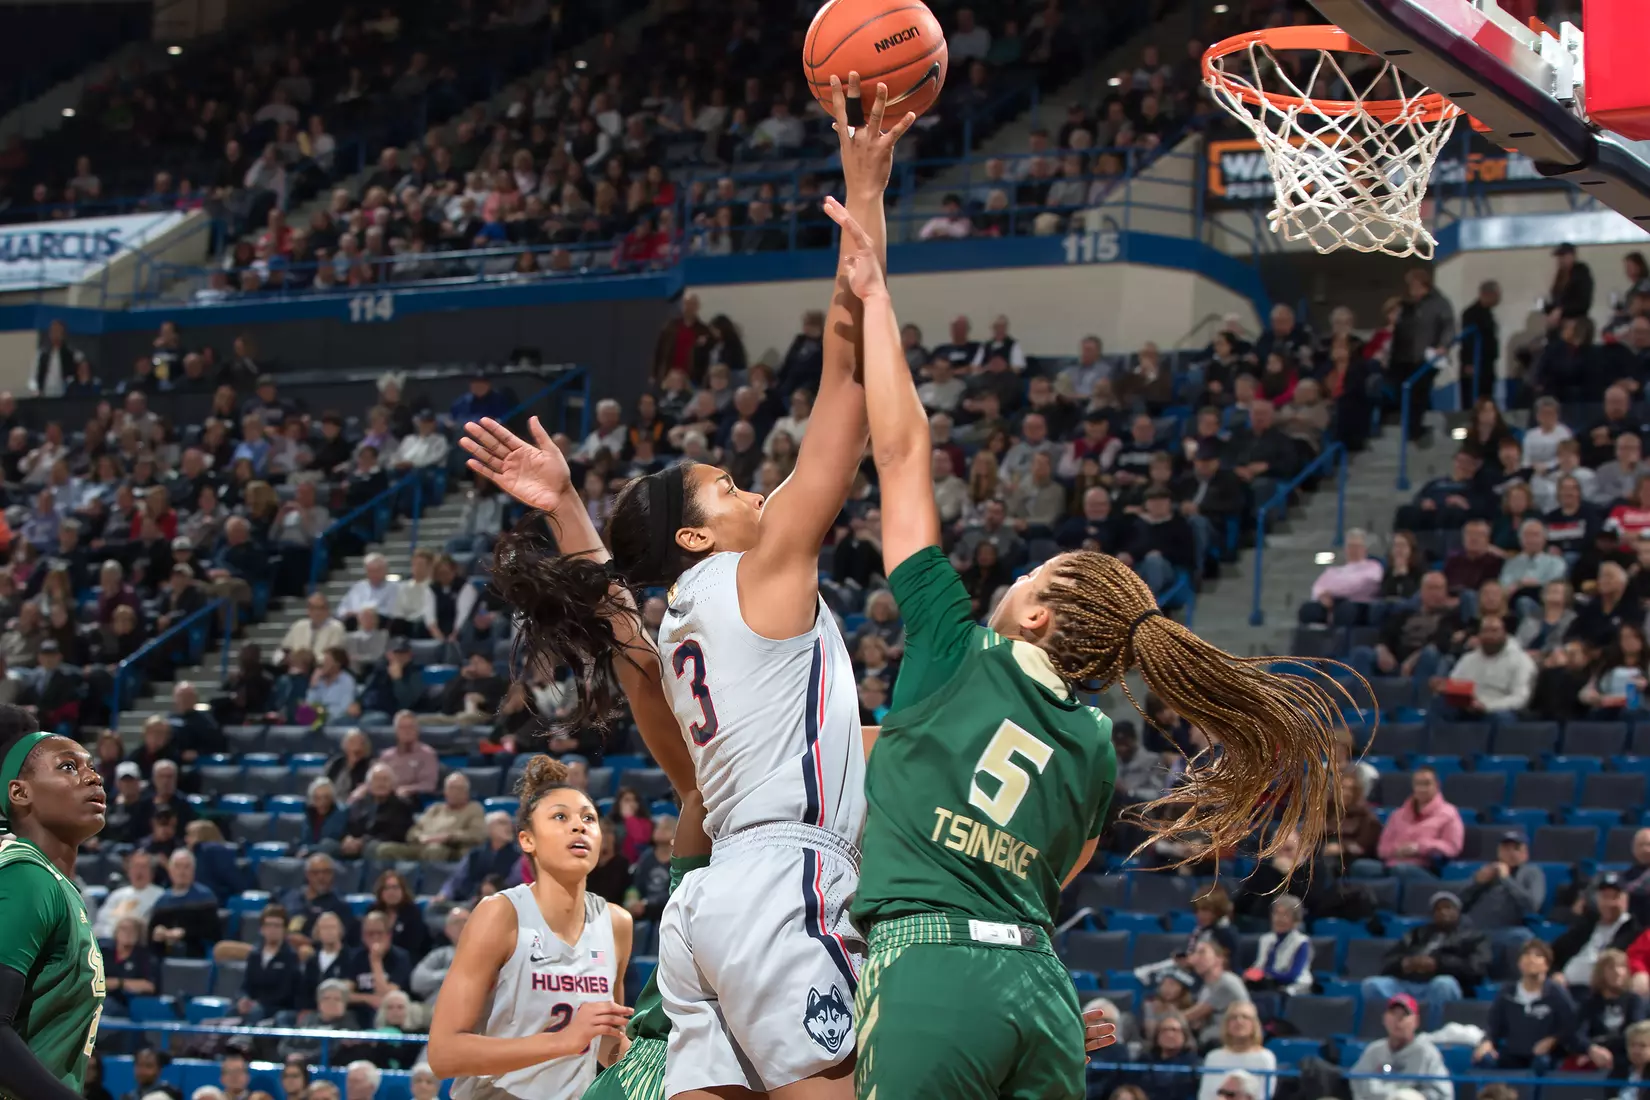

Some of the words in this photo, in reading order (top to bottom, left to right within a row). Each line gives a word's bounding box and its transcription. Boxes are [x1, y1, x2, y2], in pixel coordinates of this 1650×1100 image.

[874, 26, 920, 53] UCONN
[1062, 233, 1120, 263] 115
[349, 293, 394, 322] 114
[672, 639, 719, 747] 3
[968, 718, 1055, 827] 5
[931, 807, 1039, 881] TSINEKE
[531, 973, 609, 994] HUSKIES
